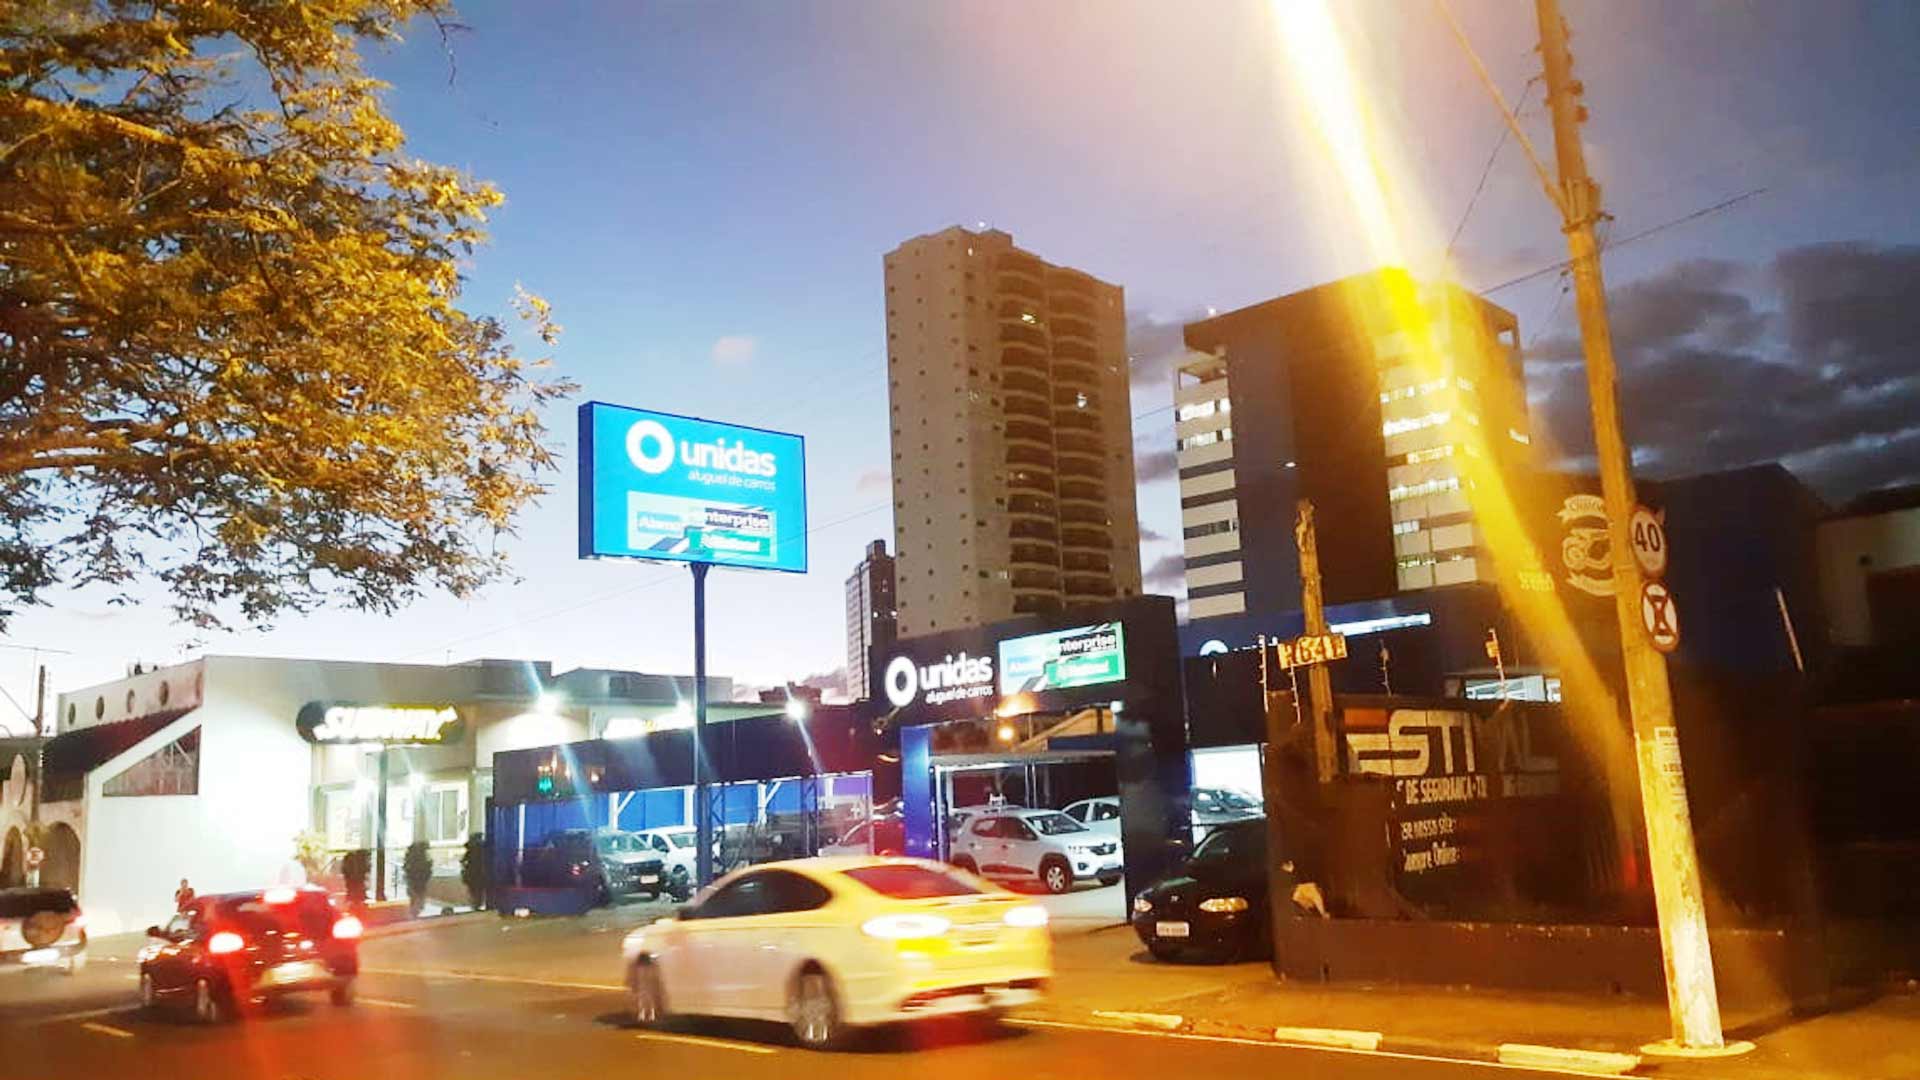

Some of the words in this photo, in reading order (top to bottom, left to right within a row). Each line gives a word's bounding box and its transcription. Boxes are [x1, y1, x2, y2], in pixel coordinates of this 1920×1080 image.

[680, 438, 777, 477] unidas
[688, 469, 728, 486] aluguel
[728, 475, 743, 486] de
[743, 478, 777, 491] carros
[1636, 522, 1660, 552] 40
[1058, 633, 1116, 653] nterprise
[920, 651, 994, 691] unidas
[925, 686, 955, 705] aluguel
[967, 685, 994, 698] carros
